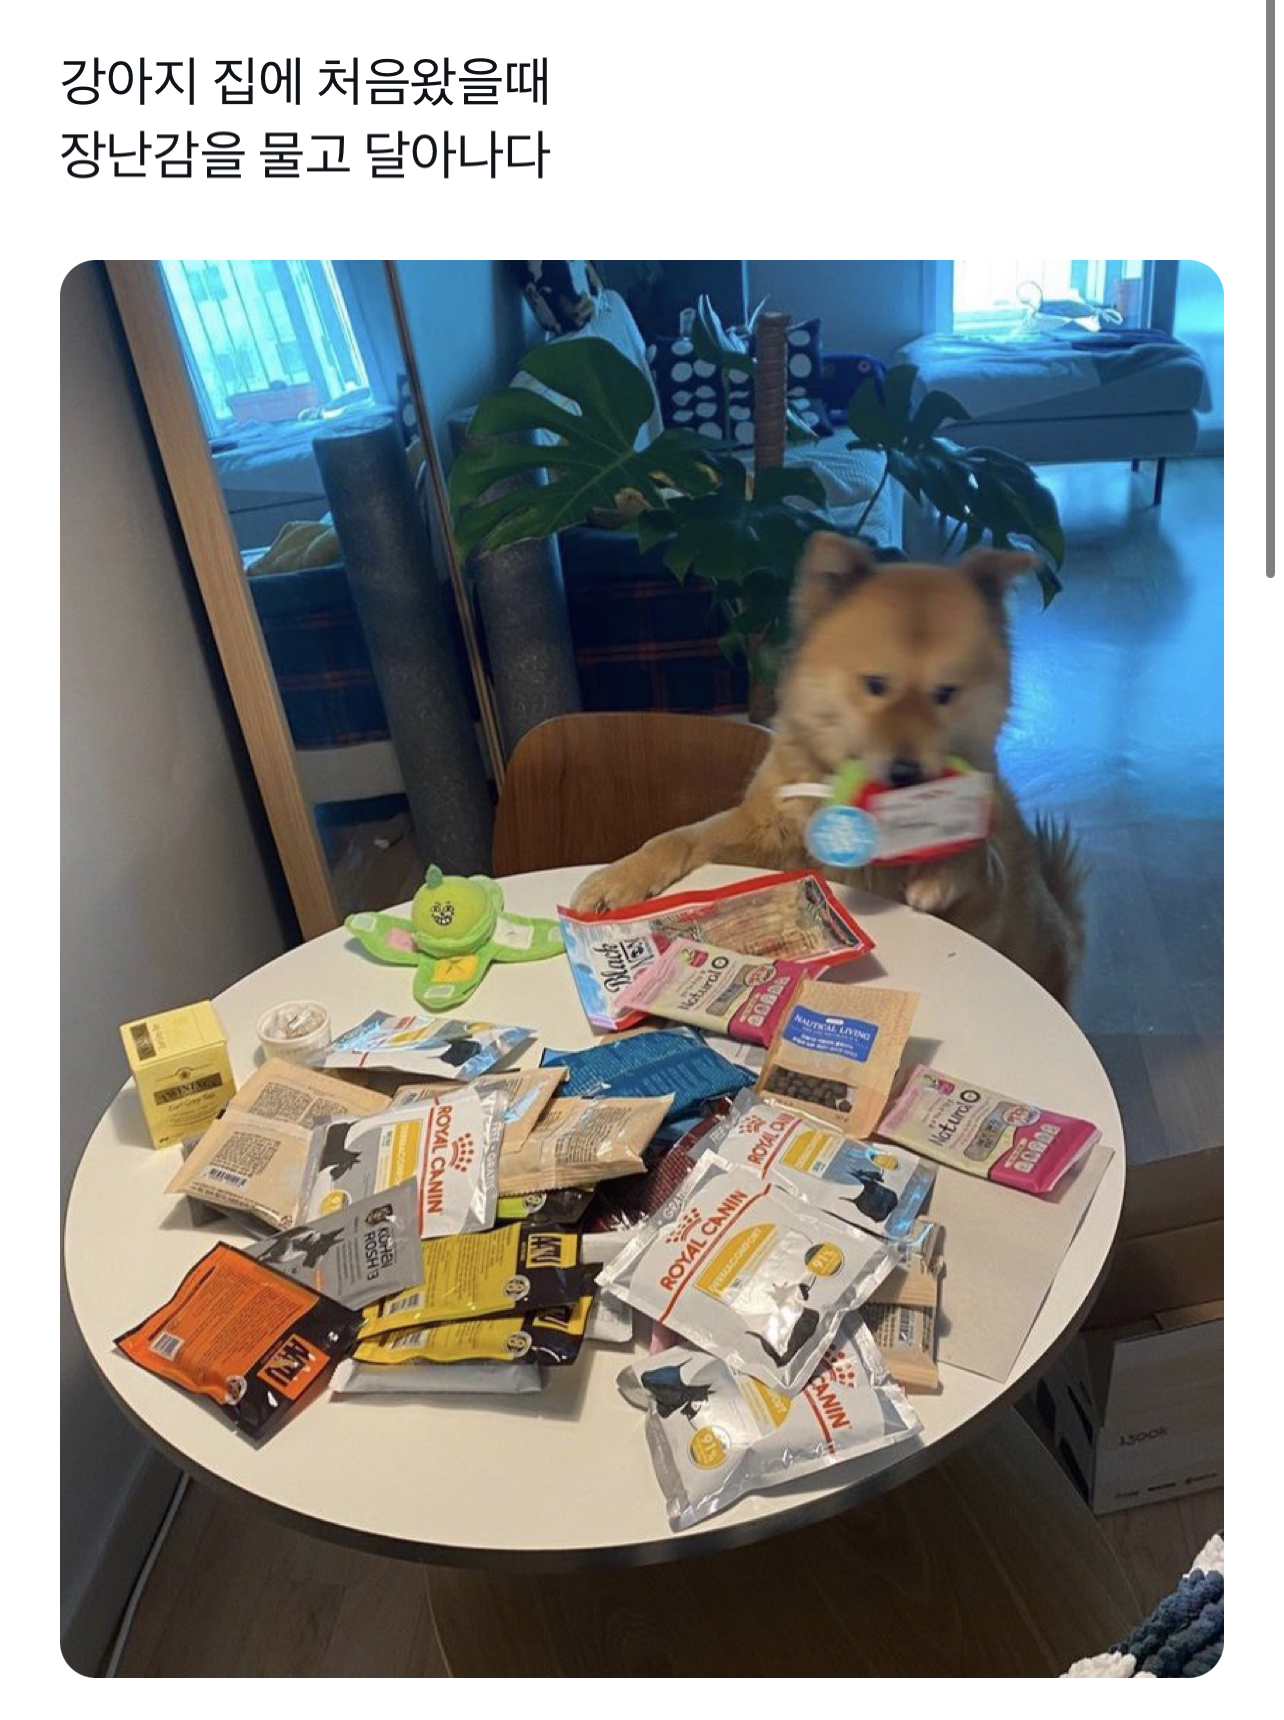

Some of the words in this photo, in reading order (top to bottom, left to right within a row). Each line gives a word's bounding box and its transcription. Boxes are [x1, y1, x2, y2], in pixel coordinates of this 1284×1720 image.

[594, 943, 632, 992] Black
[840, 1026, 870, 1041] LIVING
[431, 1104, 453, 1155] ROYAL
[747, 1132, 779, 1165] ROYAL
[427, 1156, 446, 1213] CANIN
[660, 1236, 708, 1291] ROYAL
[701, 1190, 749, 1236] CANIN
[812, 1371, 850, 1430] CANIN
